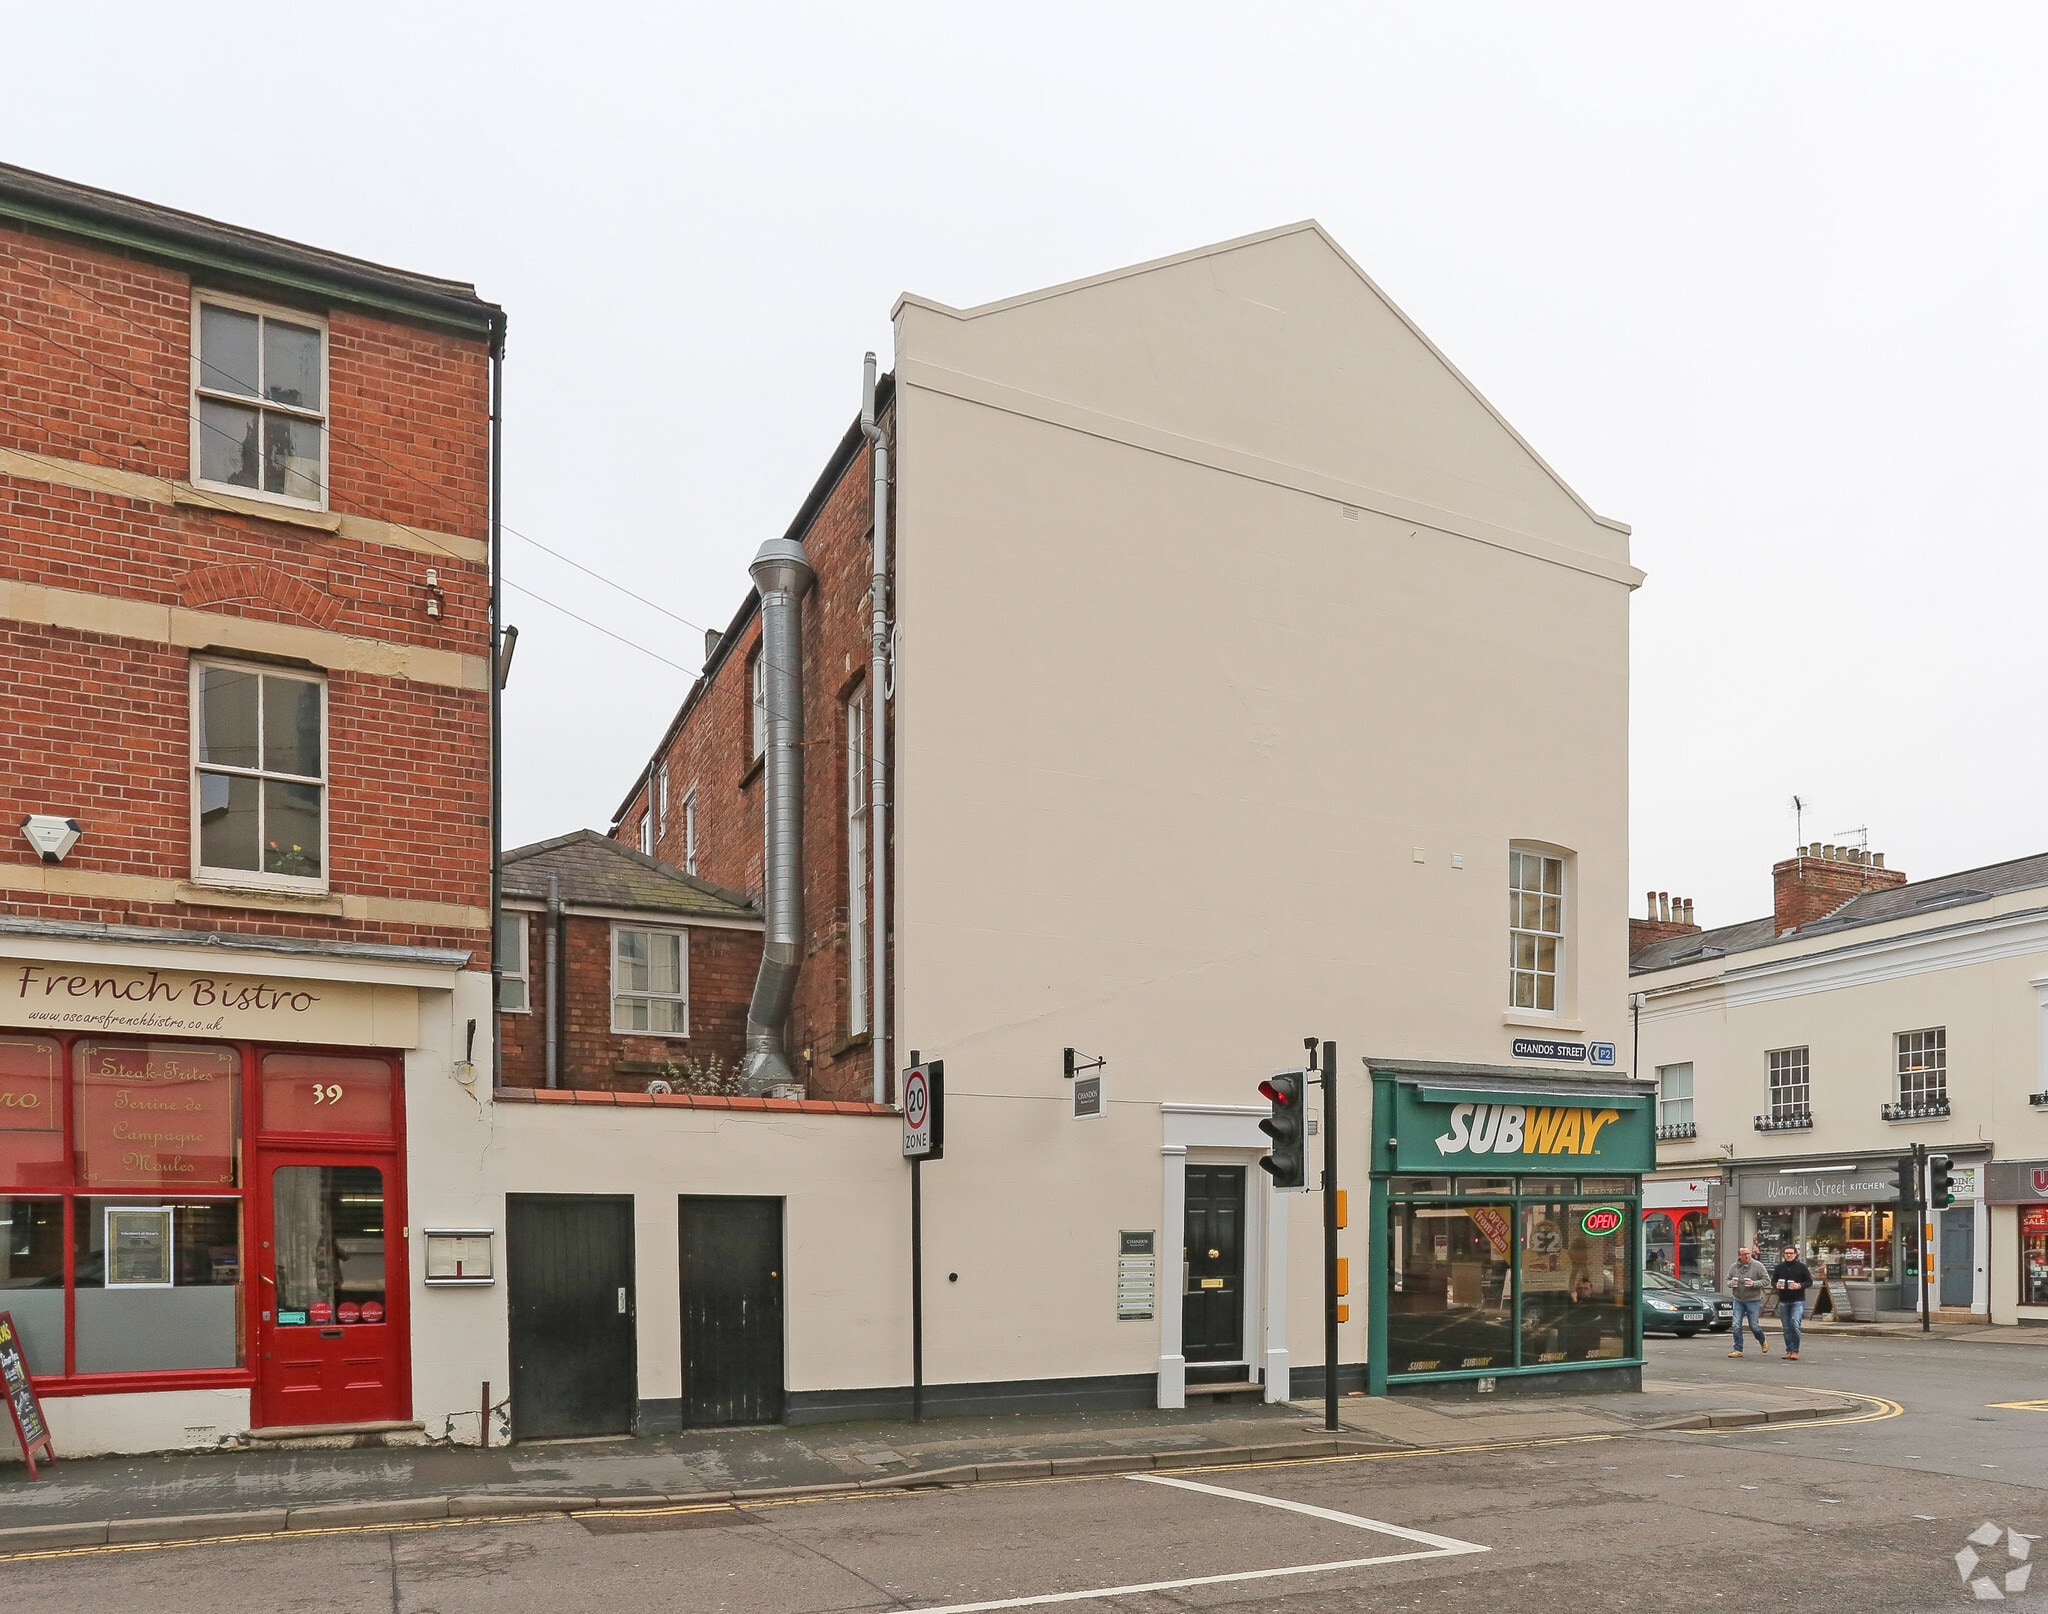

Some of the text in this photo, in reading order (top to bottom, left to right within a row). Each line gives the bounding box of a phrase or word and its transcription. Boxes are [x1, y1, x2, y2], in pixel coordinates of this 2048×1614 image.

[18, 966, 321, 1012] French Bistro
[28, 1009, 223, 1031] www.oscarsfrenchbistro.co.uk
[1514, 1042, 1584, 1057] CHANDOS STREET
[1600, 1049, 1611, 1059] P2
[100, 1057, 215, 1082] Steak-Frites
[114, 1089, 203, 1112] Terrine de
[312, 1083, 343, 1105] 39
[908, 1087, 925, 1112] 20
[1077, 1089, 1098, 1100] CHANDOS
[112, 1120, 205, 1149] Campagne
[1434, 1102, 1620, 1156] SUBWAY
[905, 1132, 927, 1149] ZONE
[122, 1152, 195, 1173] Moules
[1767, 1178, 1885, 1198] Warwick Street KITCHEN
[1475, 1210, 1507, 1251] from 7am
[1489, 1210, 1508, 1235] OPEN
[1587, 1213, 1618, 1229] OPEN
[1531, 1233, 1561, 1252] £2
[1408, 1360, 1440, 1371] SUBWAY
[1461, 1356, 1493, 1368] SUBWAY
[1538, 1351, 1568, 1362] SUBWAY
